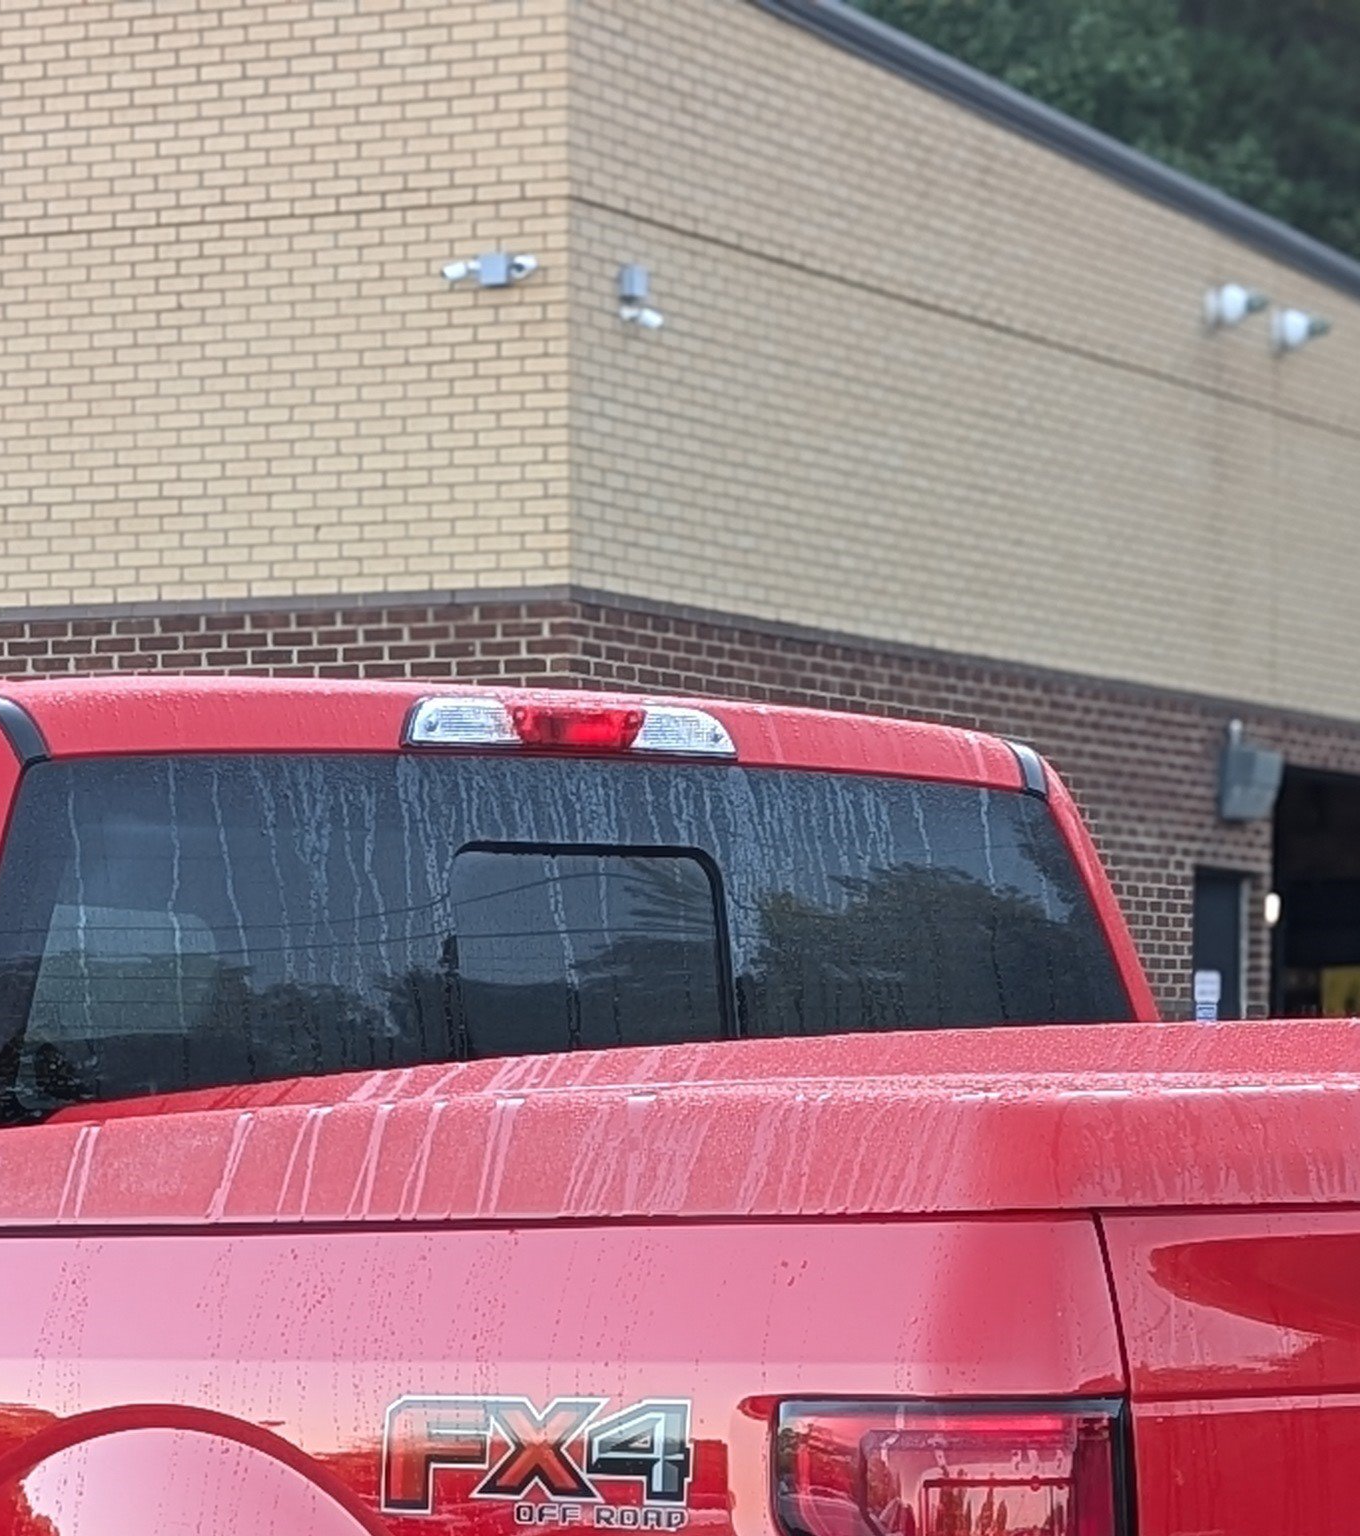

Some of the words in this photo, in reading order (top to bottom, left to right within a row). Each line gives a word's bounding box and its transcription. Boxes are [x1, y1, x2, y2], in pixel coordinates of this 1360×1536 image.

[381, 1396, 693, 1514] FX4
[514, 1502, 580, 1525] OFF
[594, 1506, 687, 1531] ROAD
